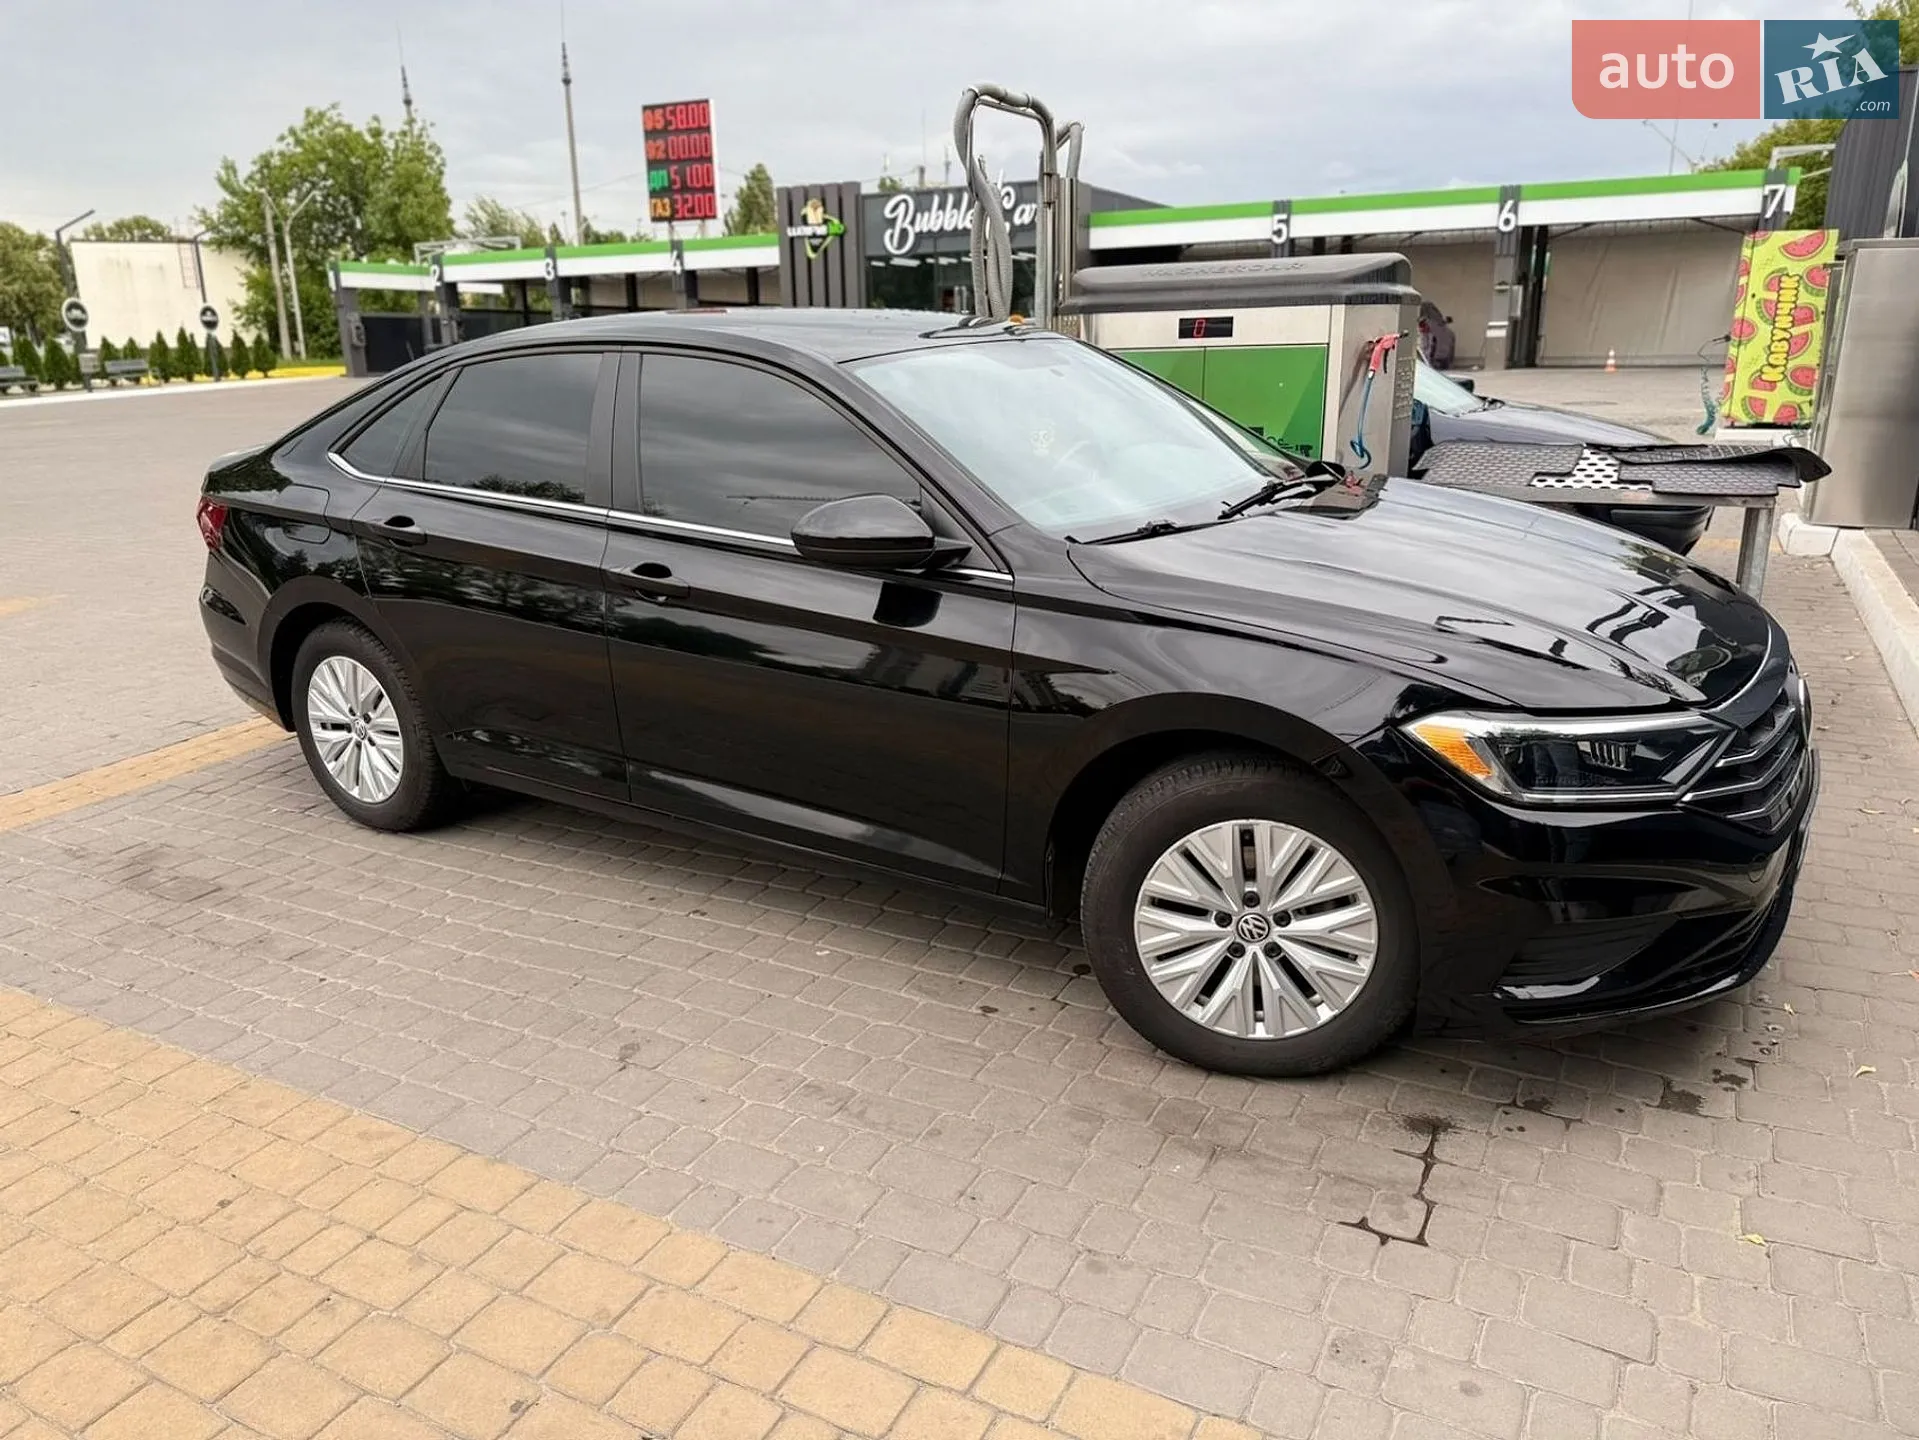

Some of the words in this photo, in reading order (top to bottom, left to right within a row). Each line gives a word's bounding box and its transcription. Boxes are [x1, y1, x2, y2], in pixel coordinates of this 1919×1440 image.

[1764, 184, 1786, 219] 7
[1271, 214, 1288, 244] 5
[1498, 200, 1517, 232] 6
[431, 265, 443, 287] 2
[543, 257, 556, 281] 3
[1193, 318, 1206, 338] 0
